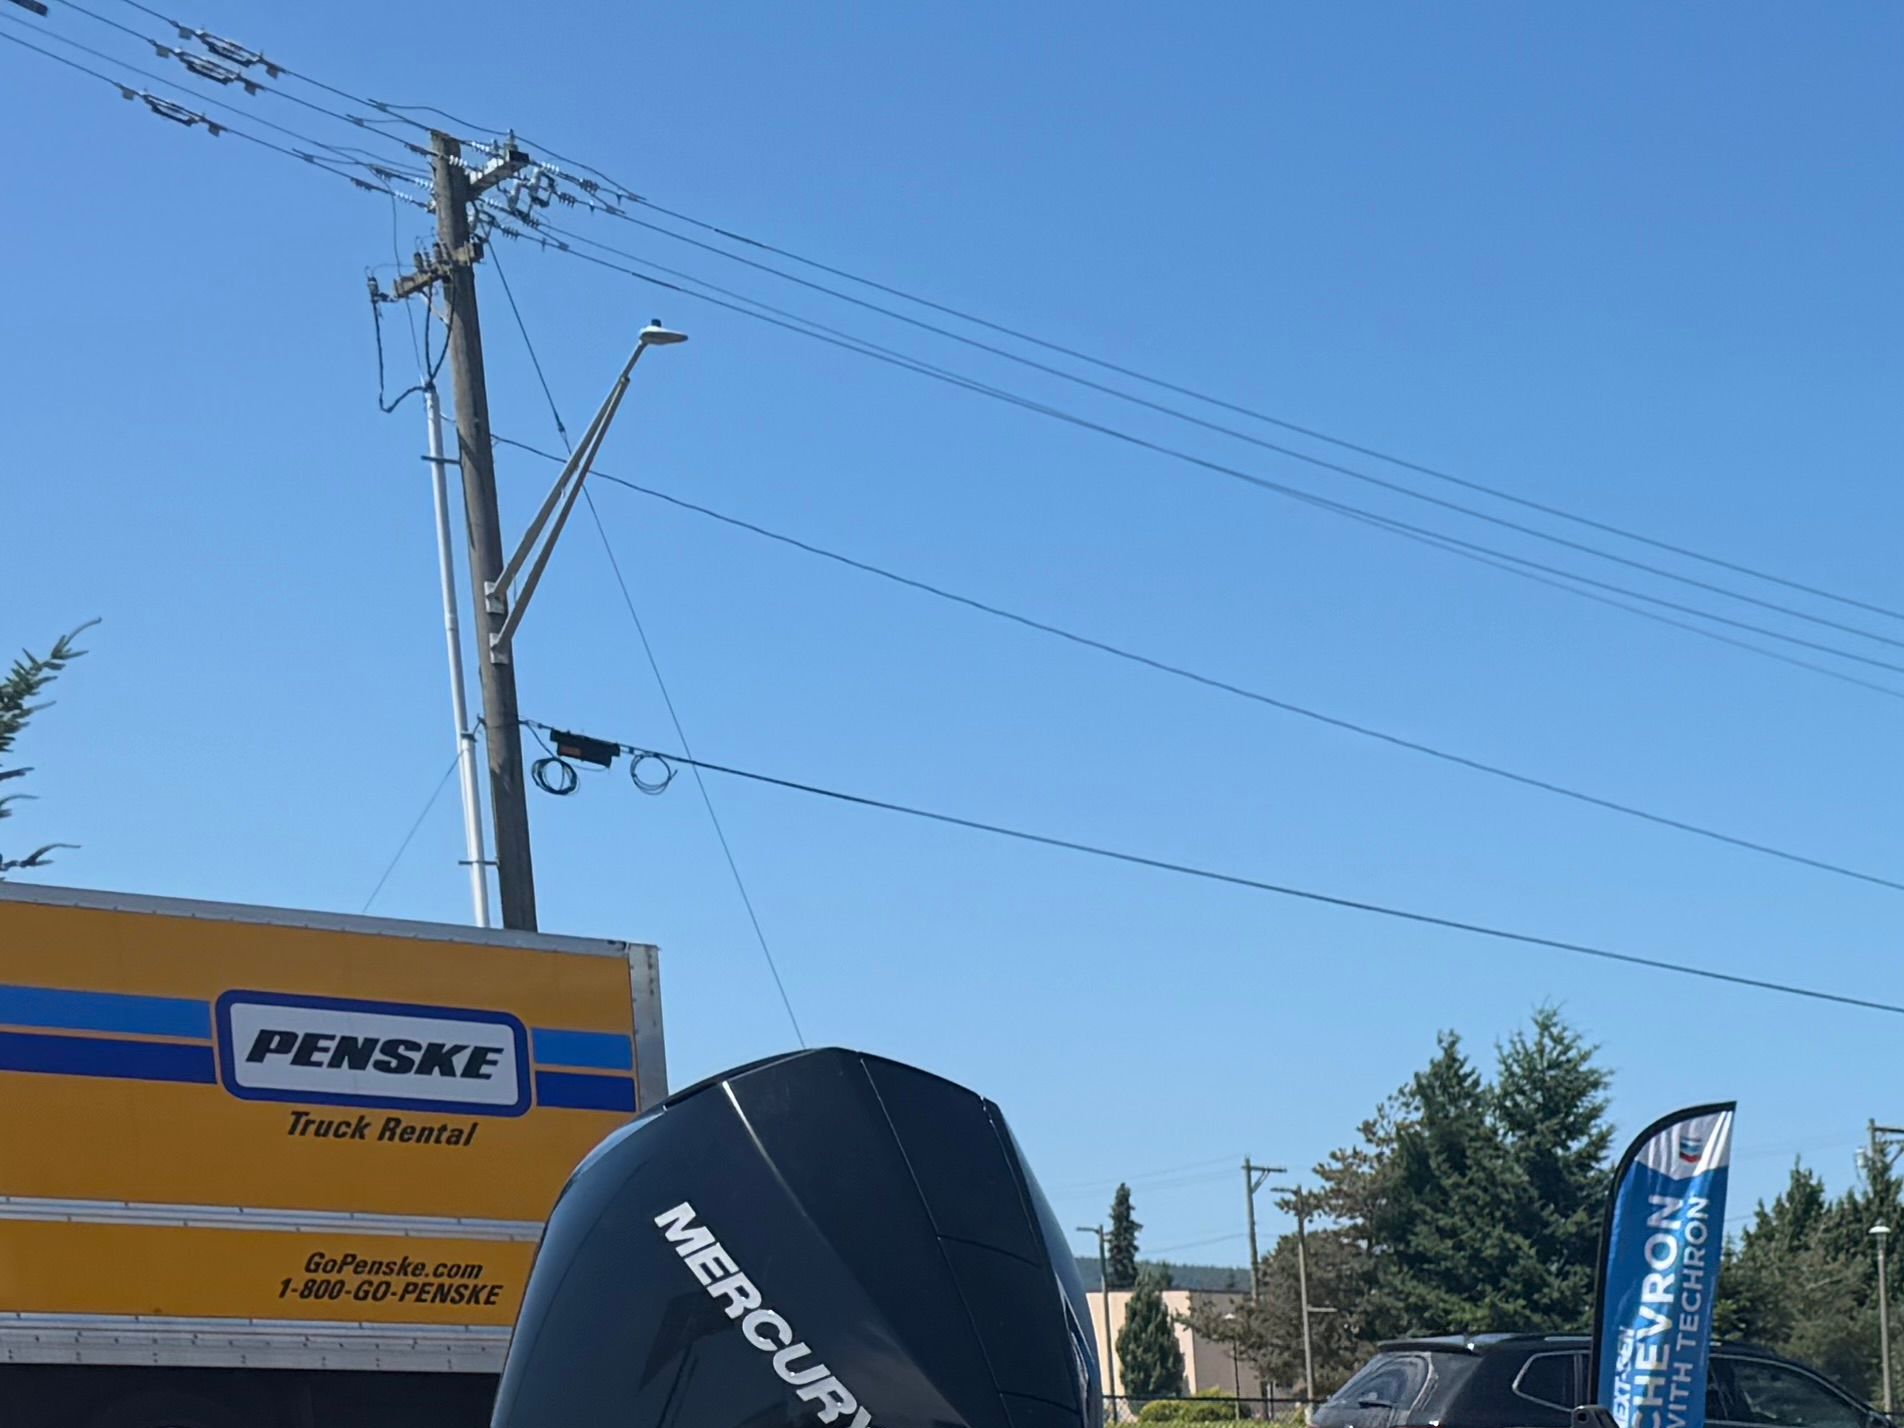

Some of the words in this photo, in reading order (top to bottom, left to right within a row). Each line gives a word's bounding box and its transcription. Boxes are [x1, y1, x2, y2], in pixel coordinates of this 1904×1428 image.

[246, 1029, 504, 1080] PENSKE
[287, 1110, 371, 1141] Truck
[377, 1117, 478, 1147] Rental
[304, 1251, 483, 1279] GoPenske.com
[1676, 1196, 1710, 1352] TECHRON
[278, 1278, 504, 1306] 1-800-GO-PENSKE
